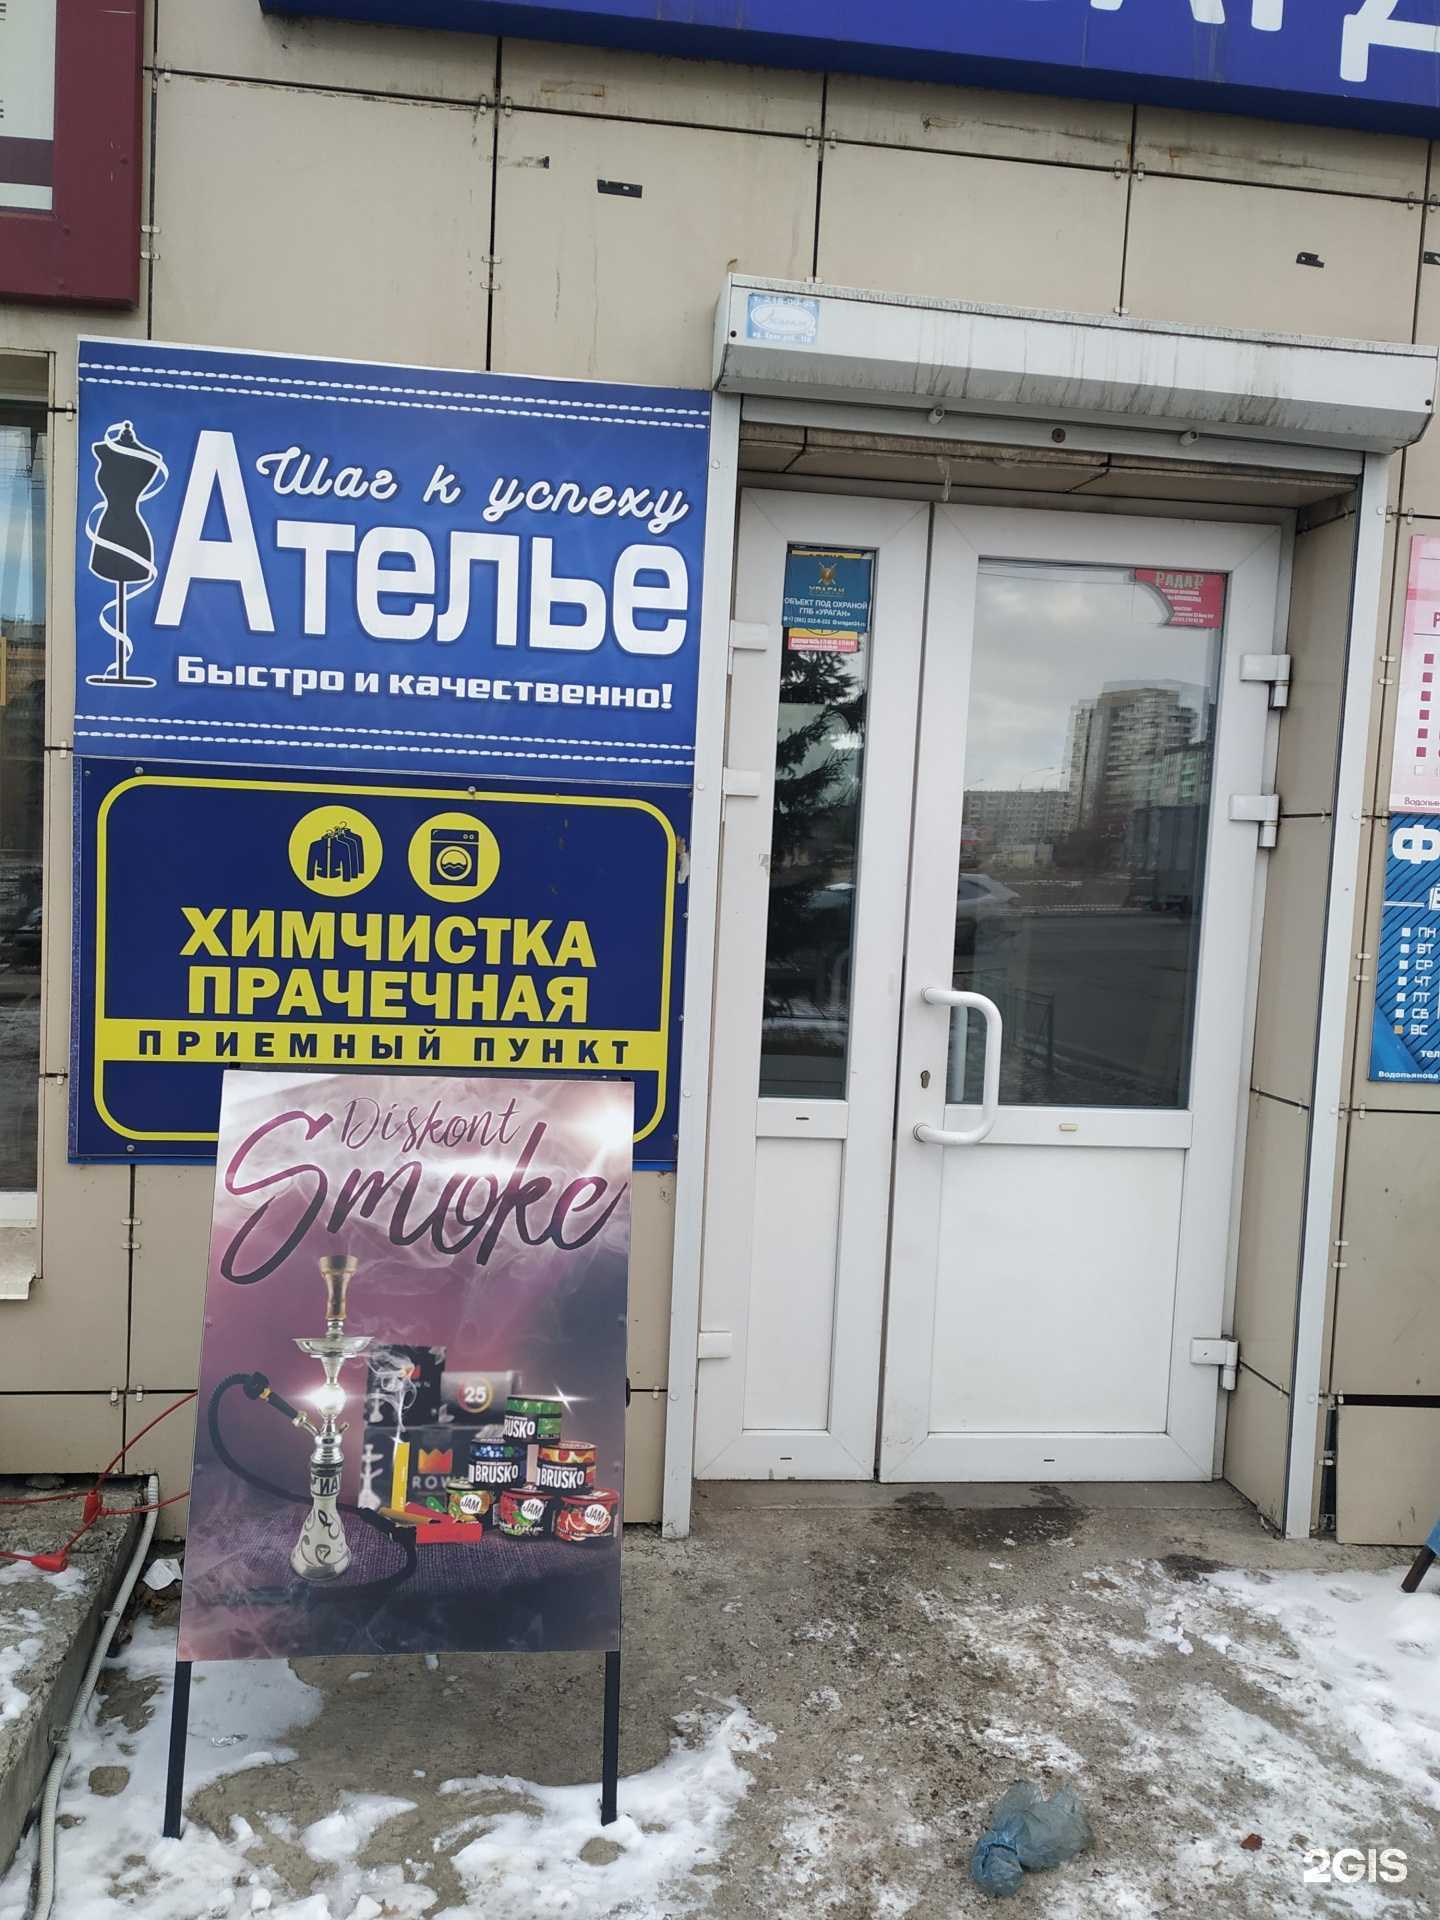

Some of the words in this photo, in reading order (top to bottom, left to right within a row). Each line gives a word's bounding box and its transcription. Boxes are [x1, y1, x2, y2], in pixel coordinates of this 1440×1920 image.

[256, 446, 398, 499] Шаг
[423, 464, 462, 504] к
[482, 478, 690, 534] успеху
[154, 429, 689, 656] Ателье
[784, 597, 814, 606] ОБЪЕКТ
[815, 600, 831, 608] ПОД
[833, 600, 868, 610] ОХРАНОЙ
[178, 656, 344, 697] Быстро
[355, 672, 379, 694] и
[390, 672, 674, 710] качественно!
[180, 907, 597, 968] ХИМЧИСТКА
[1418, 927, 1436, 938] ПН
[1417, 943, 1434, 954] ВТ
[1415, 960, 1433, 970] СР
[1414, 976, 1432, 987] ЧТ
[188, 965, 589, 1024] ПРАЧЕЧНАЯ
[1413, 992, 1430, 1003] ПТ
[1411, 1008, 1429, 1019] СБ
[1410, 1024, 1428, 1035] ВС
[138, 1028, 441, 1062] ПРИЕМНЫЙ
[474, 1038, 630, 1066] ПУНКТ
[341, 1097, 521, 1152] Diskont
[220, 1110, 628, 1285] Smoke
[464, 1386, 487, 1404] 25
[475, 1463, 519, 1484] BRUSKO
[540, 1467, 585, 1489] BRUSKO
[460, 1497, 481, 1511] JAM
[522, 1501, 544, 1516] JAM
[586, 1508, 606, 1523] JAM
